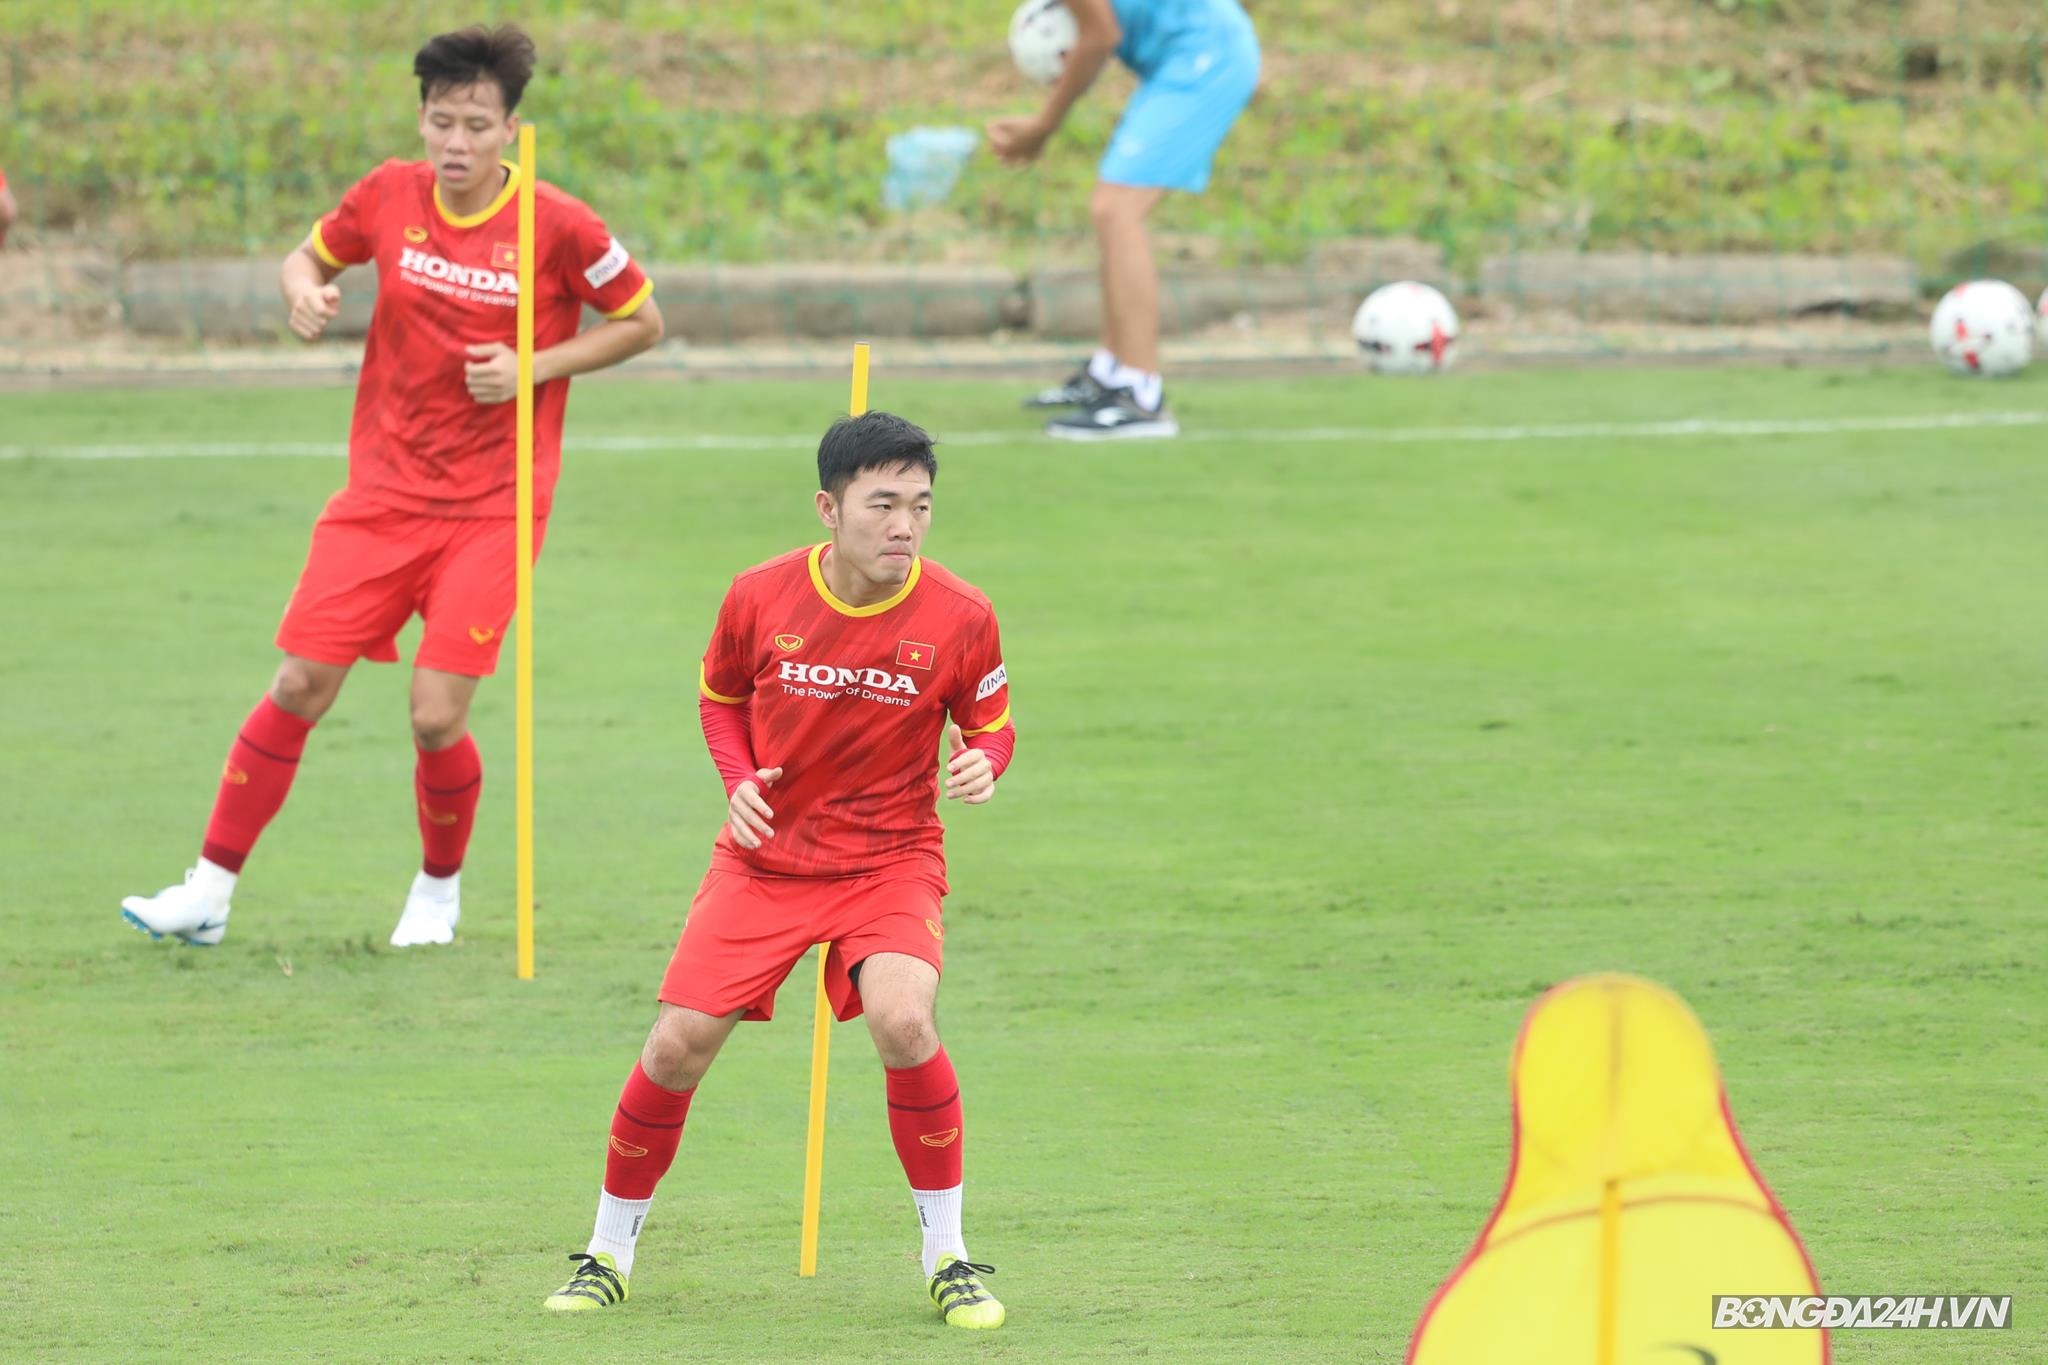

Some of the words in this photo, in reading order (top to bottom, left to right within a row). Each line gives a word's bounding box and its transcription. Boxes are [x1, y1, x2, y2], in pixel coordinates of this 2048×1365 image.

[398, 246, 519, 294] HONDA
[777, 661, 920, 695] HONDA
[979, 669, 1006, 694] VINA
[781, 683, 805, 696] The
[845, 686, 860, 697] of
[861, 690, 911, 707] Dreams
